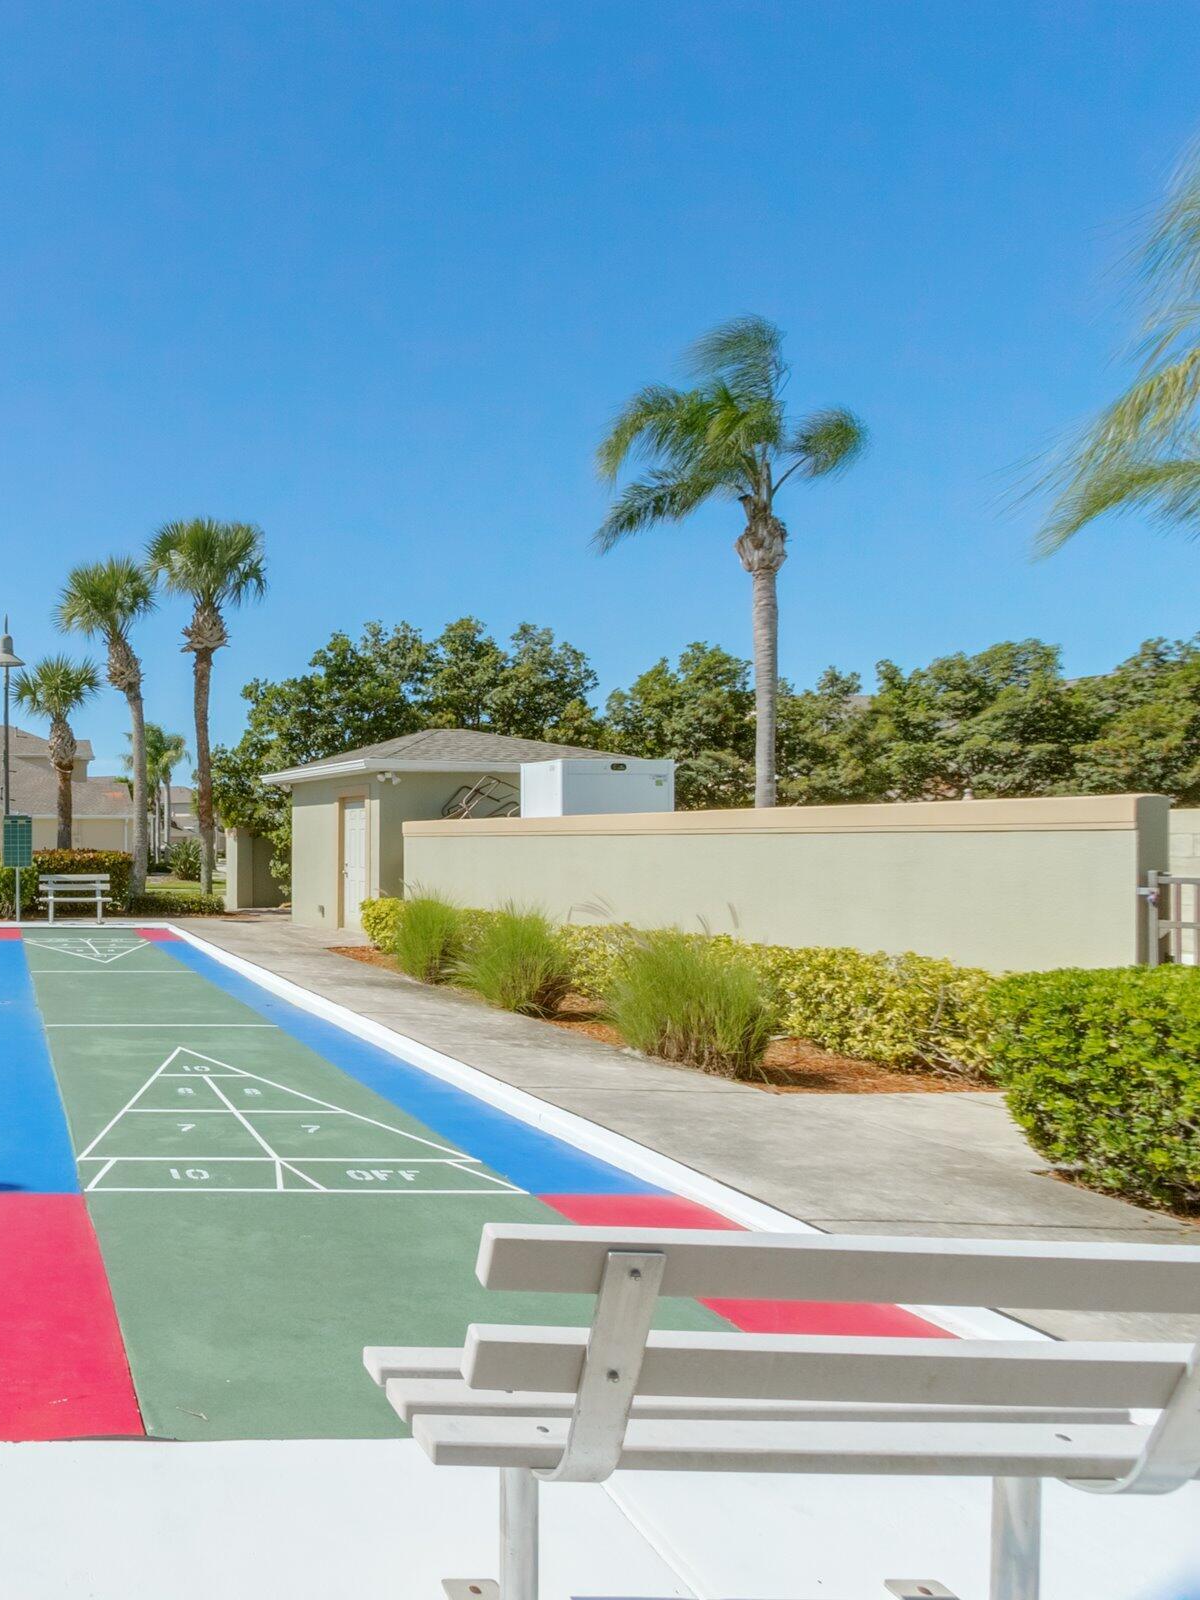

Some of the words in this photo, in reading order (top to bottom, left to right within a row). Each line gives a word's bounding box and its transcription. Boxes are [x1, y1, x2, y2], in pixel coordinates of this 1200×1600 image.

[182, 1064, 211, 1072] 10
[176, 1123, 196, 1132] 7
[300, 1124, 321, 1134] 7
[169, 1168, 211, 1180] 10
[345, 1169, 421, 1182] OFF
